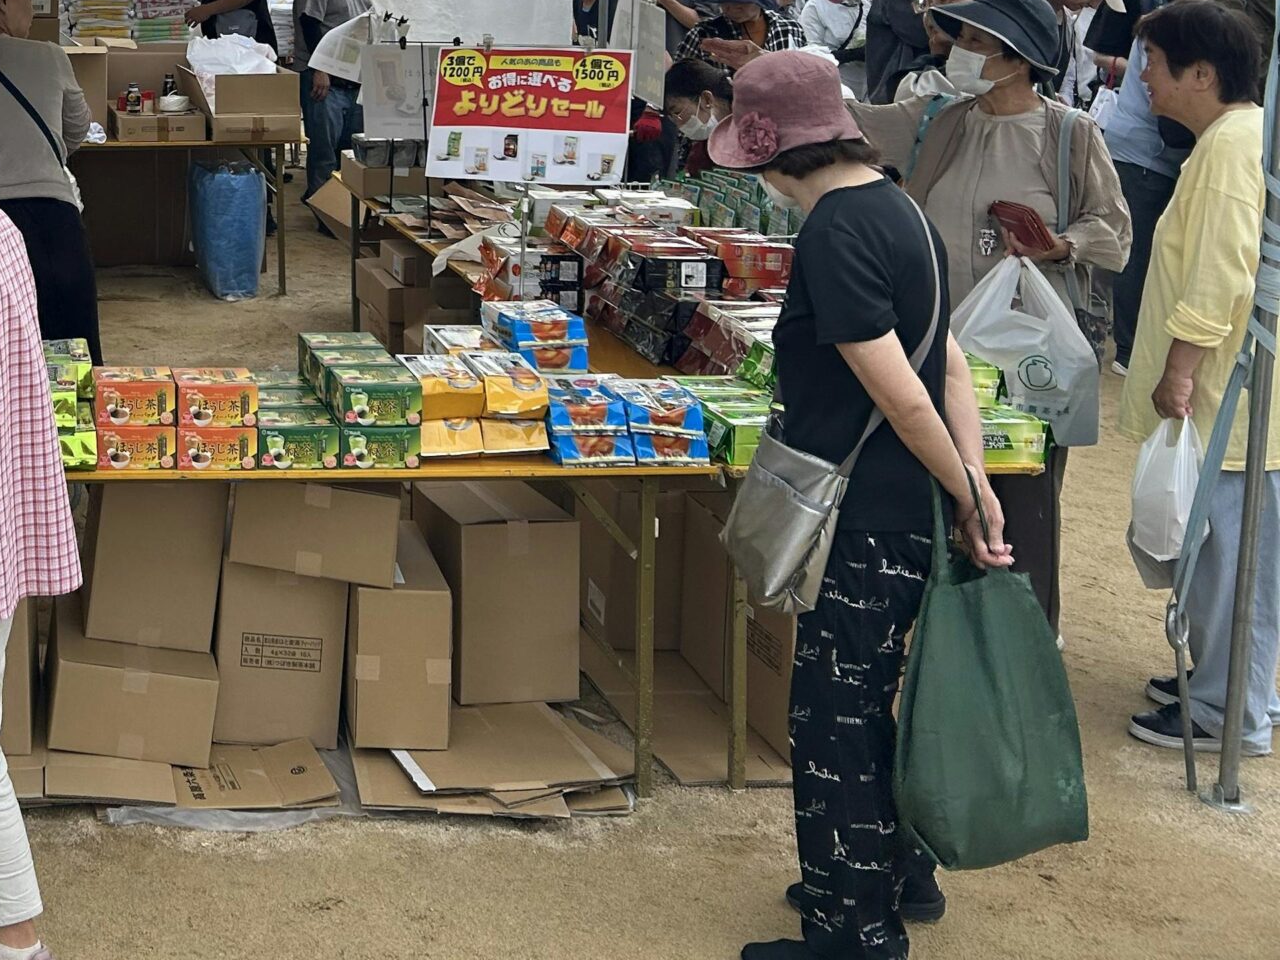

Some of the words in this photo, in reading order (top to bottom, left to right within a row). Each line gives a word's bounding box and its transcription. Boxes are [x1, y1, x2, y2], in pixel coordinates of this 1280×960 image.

[447, 56, 476, 66] 3個で
[580, 59, 614, 70] 4個で
[443, 66, 483, 78] 1200円
[575, 69, 619, 81] 1500円
[488, 72, 573, 92] お得に選べる
[453, 90, 606, 119] よりどりセール
[115, 398, 157, 412] ほうじ茶
[198, 400, 240, 413] ほうじ茶
[116, 441, 157, 455] ほうじ茶
[197, 442, 239, 455] ほうじ茶
